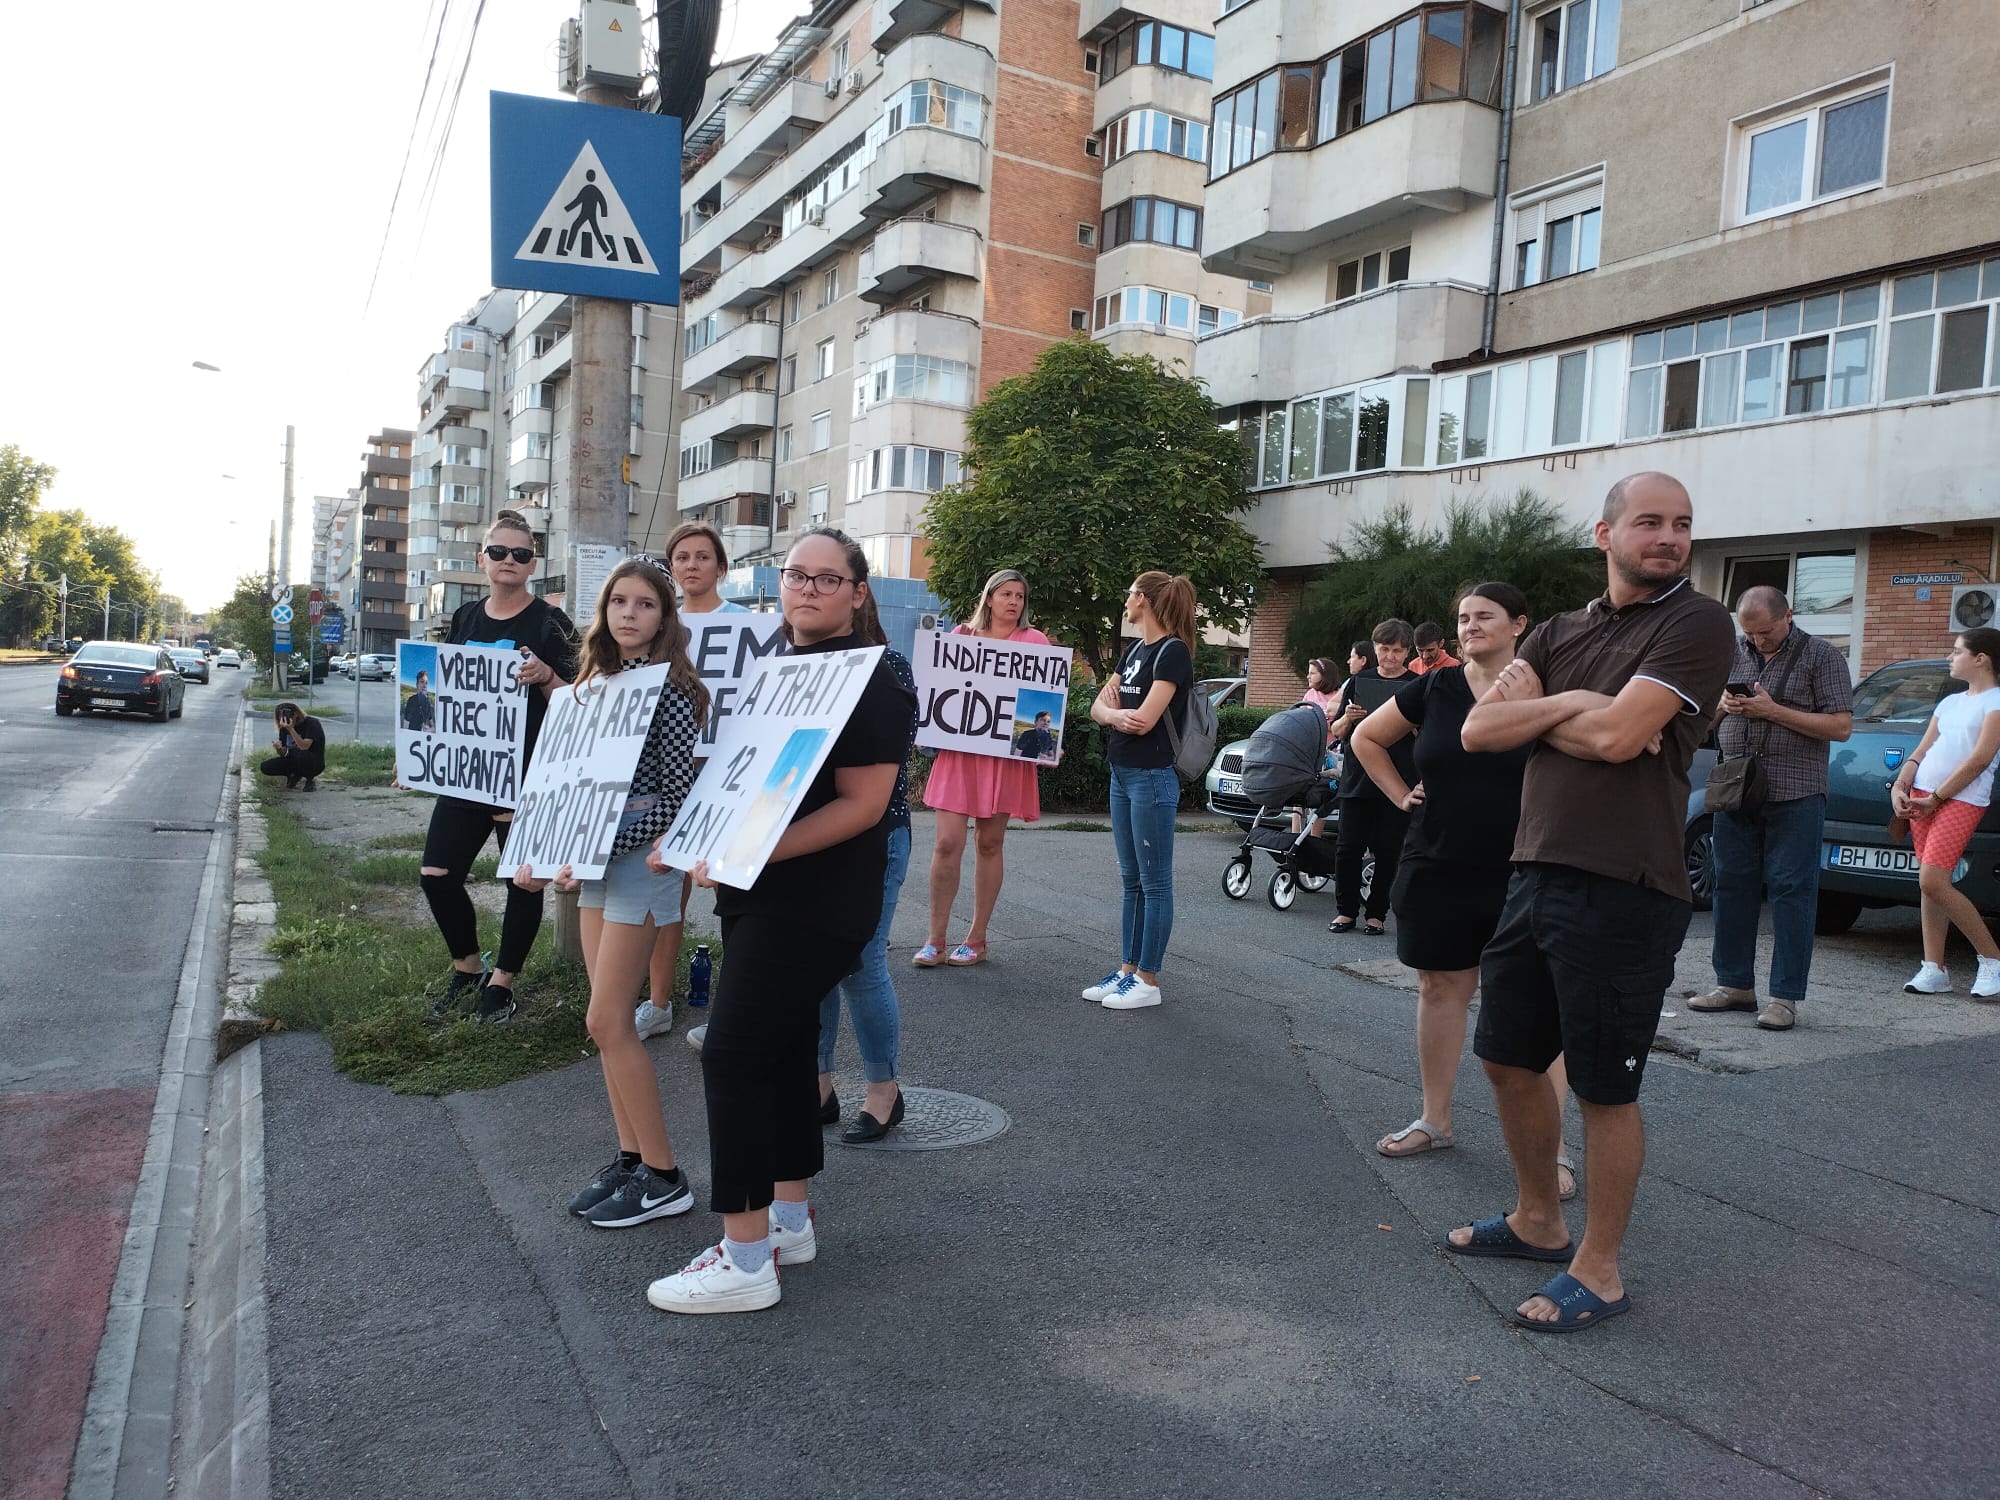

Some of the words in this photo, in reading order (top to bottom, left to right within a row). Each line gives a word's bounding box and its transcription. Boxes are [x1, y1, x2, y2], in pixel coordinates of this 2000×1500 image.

[1893, 576, 1915, 585] Calea
[1916, 574, 1961, 584] ARADULUI
[309, 601, 323, 615] STOP
[439, 651, 502, 694] VREAU
[737, 671, 768, 715] A
[438, 695, 487, 737] TREC
[496, 694, 517, 742] ÎN
[600, 685, 661, 738] ARE
[500, 766, 632, 866] PRIORITATE
[667, 801, 735, 859] ANI
[1841, 848, 1866, 866] BH
[1874, 851, 1891, 868] 10
